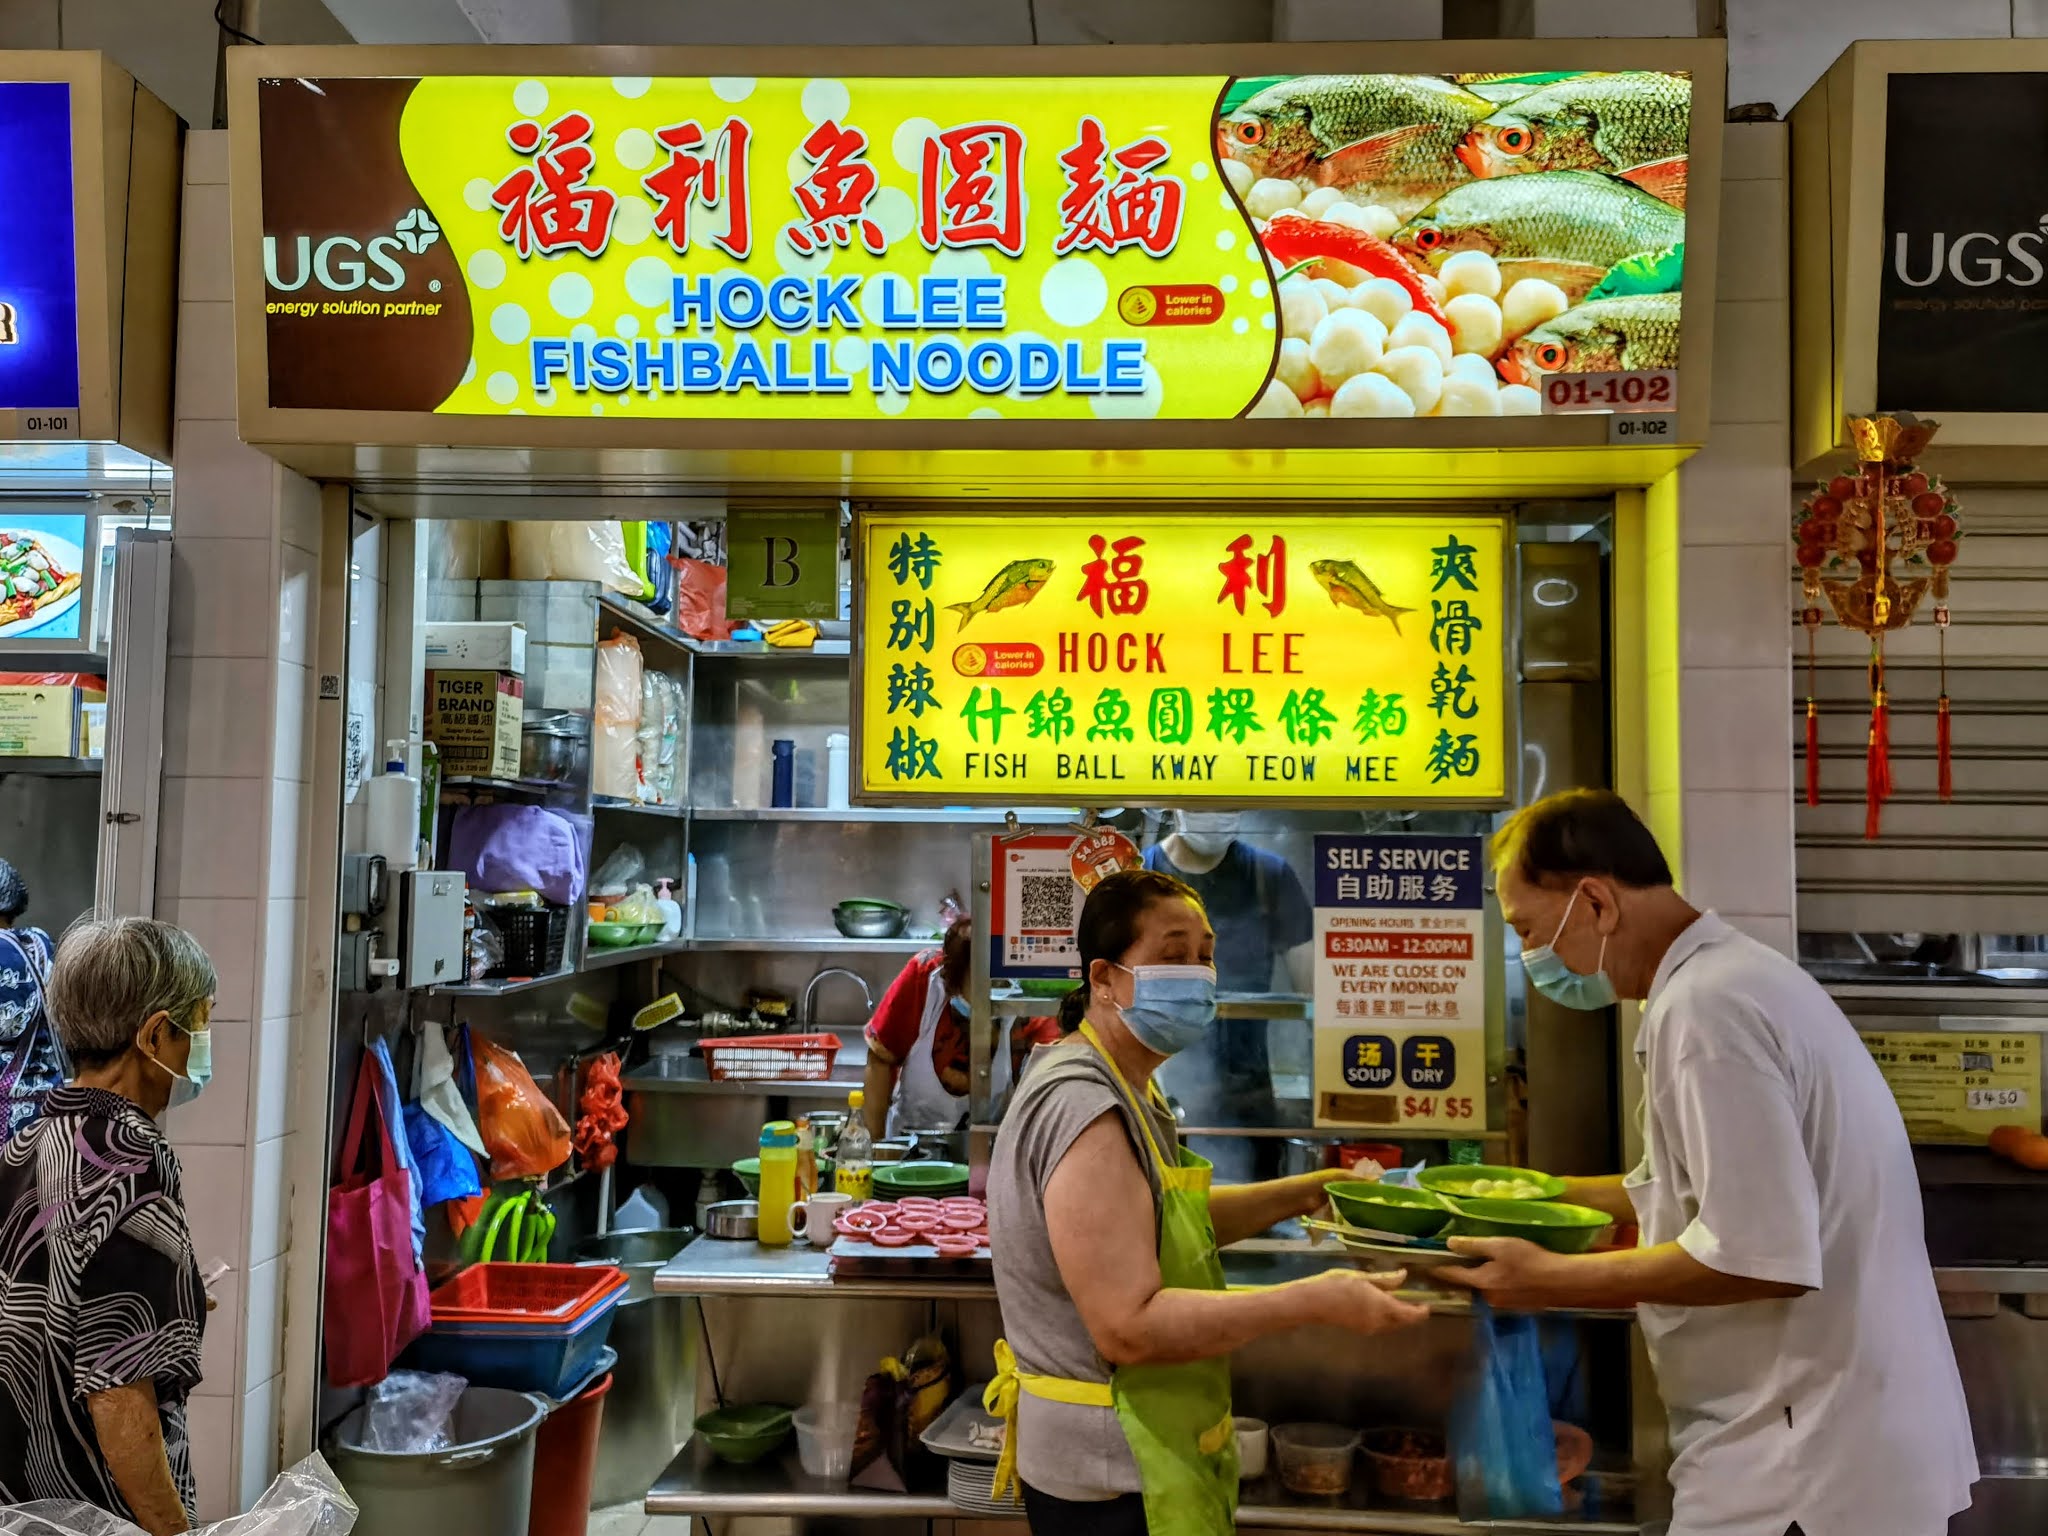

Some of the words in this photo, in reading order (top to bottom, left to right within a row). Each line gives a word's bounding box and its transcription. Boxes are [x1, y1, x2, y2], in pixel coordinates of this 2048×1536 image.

[263, 236, 405, 292] UGS
[1895, 232, 2044, 287] UGS
[266, 302, 319, 317] energy
[322, 300, 380, 315] solution
[384, 301, 442, 317] partner
[671, 275, 862, 326] HOCK
[881, 276, 1004, 326] LEE
[1165, 294, 1200, 305] Lower
[1202, 293, 1213, 304] in
[1165, 305, 1212, 316] calories
[531, 339, 852, 390] FISHBALL
[870, 340, 1145, 391] NOODLE
[1548, 375, 1670, 405] 01-102
[27, 417, 68, 430] 01-101
[1619, 421, 1667, 435] 01-102
[761, 537, 800, 587] B
[1076, 534, 1286, 619] 福利
[885, 531, 943, 782] 特別辣椒
[993, 650, 1024, 660] Lower
[1026, 650, 1035, 659] in
[1058, 632, 1167, 674] HOCK
[1222, 632, 1305, 674] LEE
[1424, 533, 1482, 785] 爽滑乾麵
[994, 660, 1034, 670] calories
[438, 680, 484, 695] TIGER
[437, 698, 495, 713] BRAND
[964, 752, 1027, 779] FISH
[1056, 753, 1126, 780] BALL
[1152, 754, 1218, 781] KWAY
[1246, 755, 1316, 781] TEOW
[1345, 756, 1399, 782] MEE
[1327, 848, 1374, 870] SELF
[1378, 849, 1471, 871] SERVICE
[1336, 873, 1459, 902] 自助服务
[1330, 917, 1376, 928] OPENING
[1379, 918, 1415, 929] HOURS
[1331, 937, 1389, 953] 6:30AM
[1402, 938, 1468, 954] 12:00PM
[1332, 964, 1358, 977] WE
[1361, 964, 1389, 977] ARE
[1393, 965, 1437, 978] CLOSE
[1442, 966, 1467, 979] ON
[1341, 981, 1386, 993] EVERY
[1391, 981, 1458, 994] MONDAY
[1357, 1042, 1382, 1067] 汤
[1416, 1043, 1440, 1068] 干
[1347, 1068, 1392, 1082] SOUP
[1411, 1068, 1444, 1083] DRY
[1445, 1097, 1473, 1119] $5
